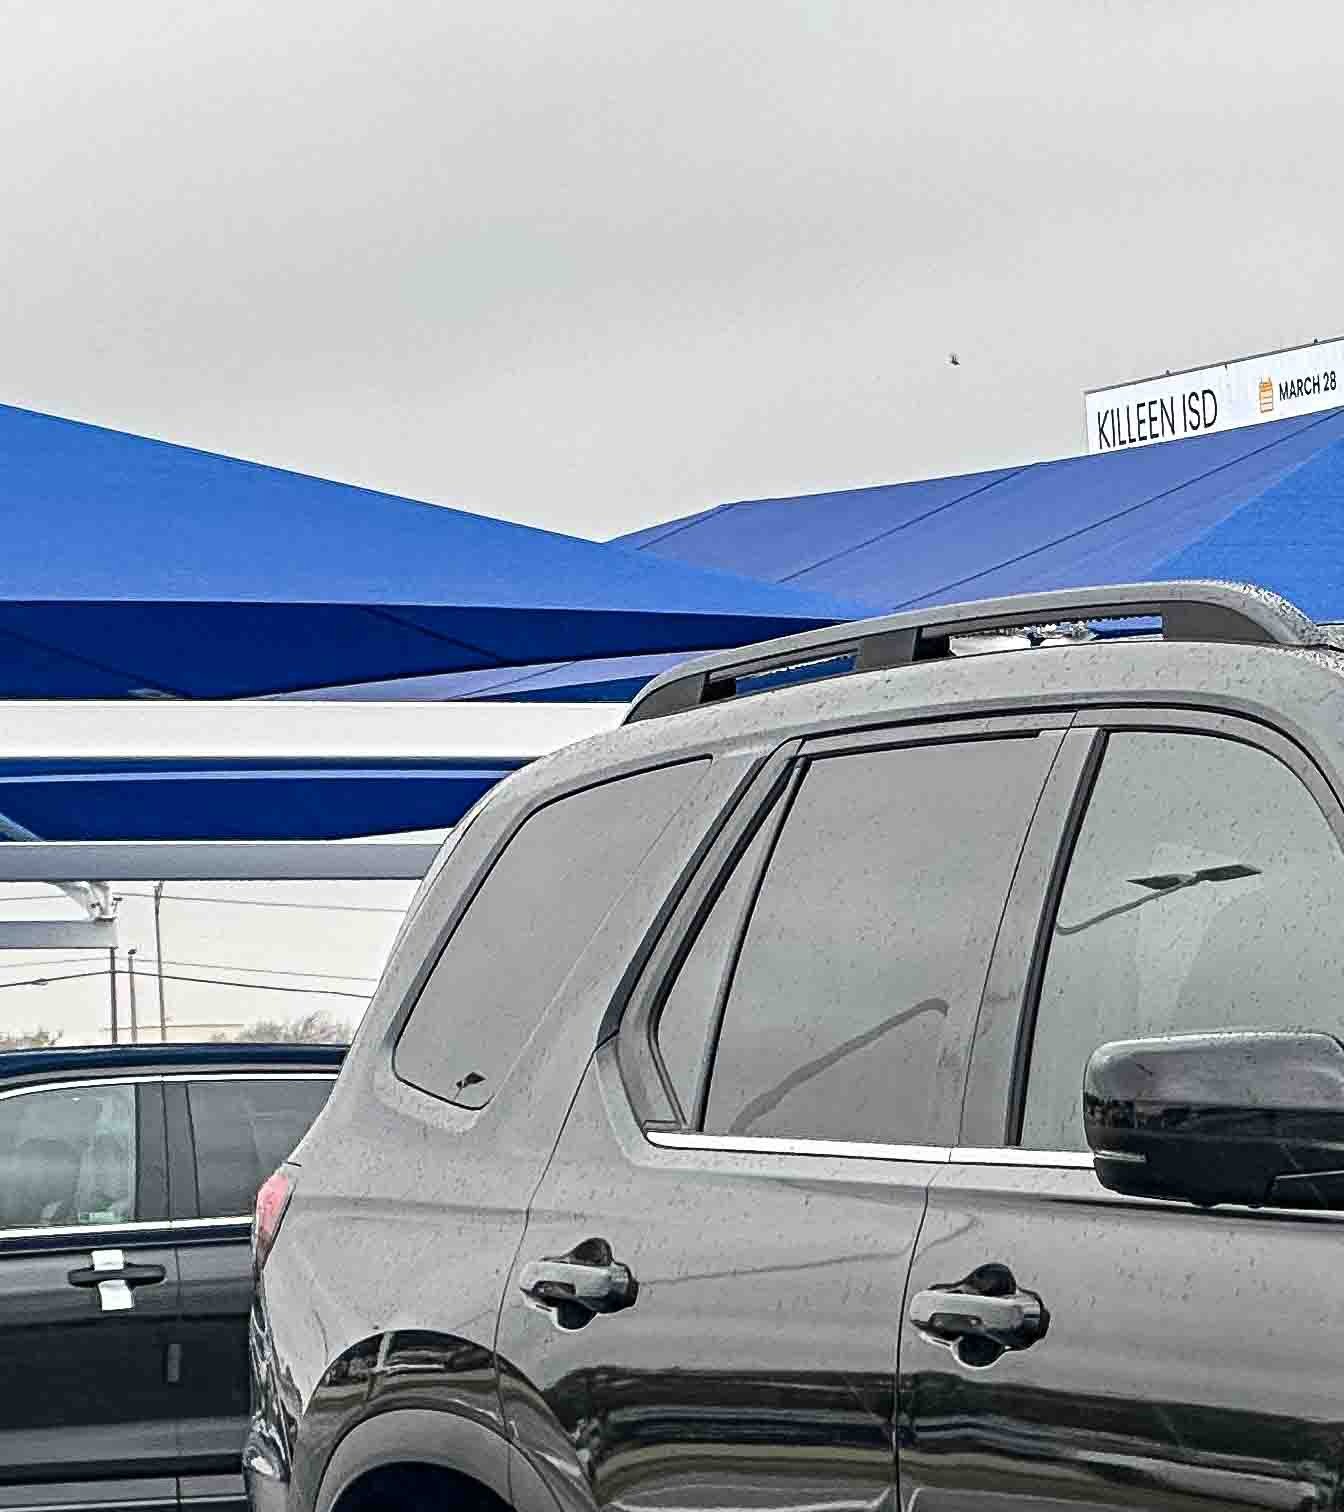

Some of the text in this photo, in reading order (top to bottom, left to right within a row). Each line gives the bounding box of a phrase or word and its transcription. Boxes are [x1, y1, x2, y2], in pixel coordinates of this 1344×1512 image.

[1279, 370, 1337, 401] MARCH 28
[1097, 389, 1218, 450] KILLEEN ISD
